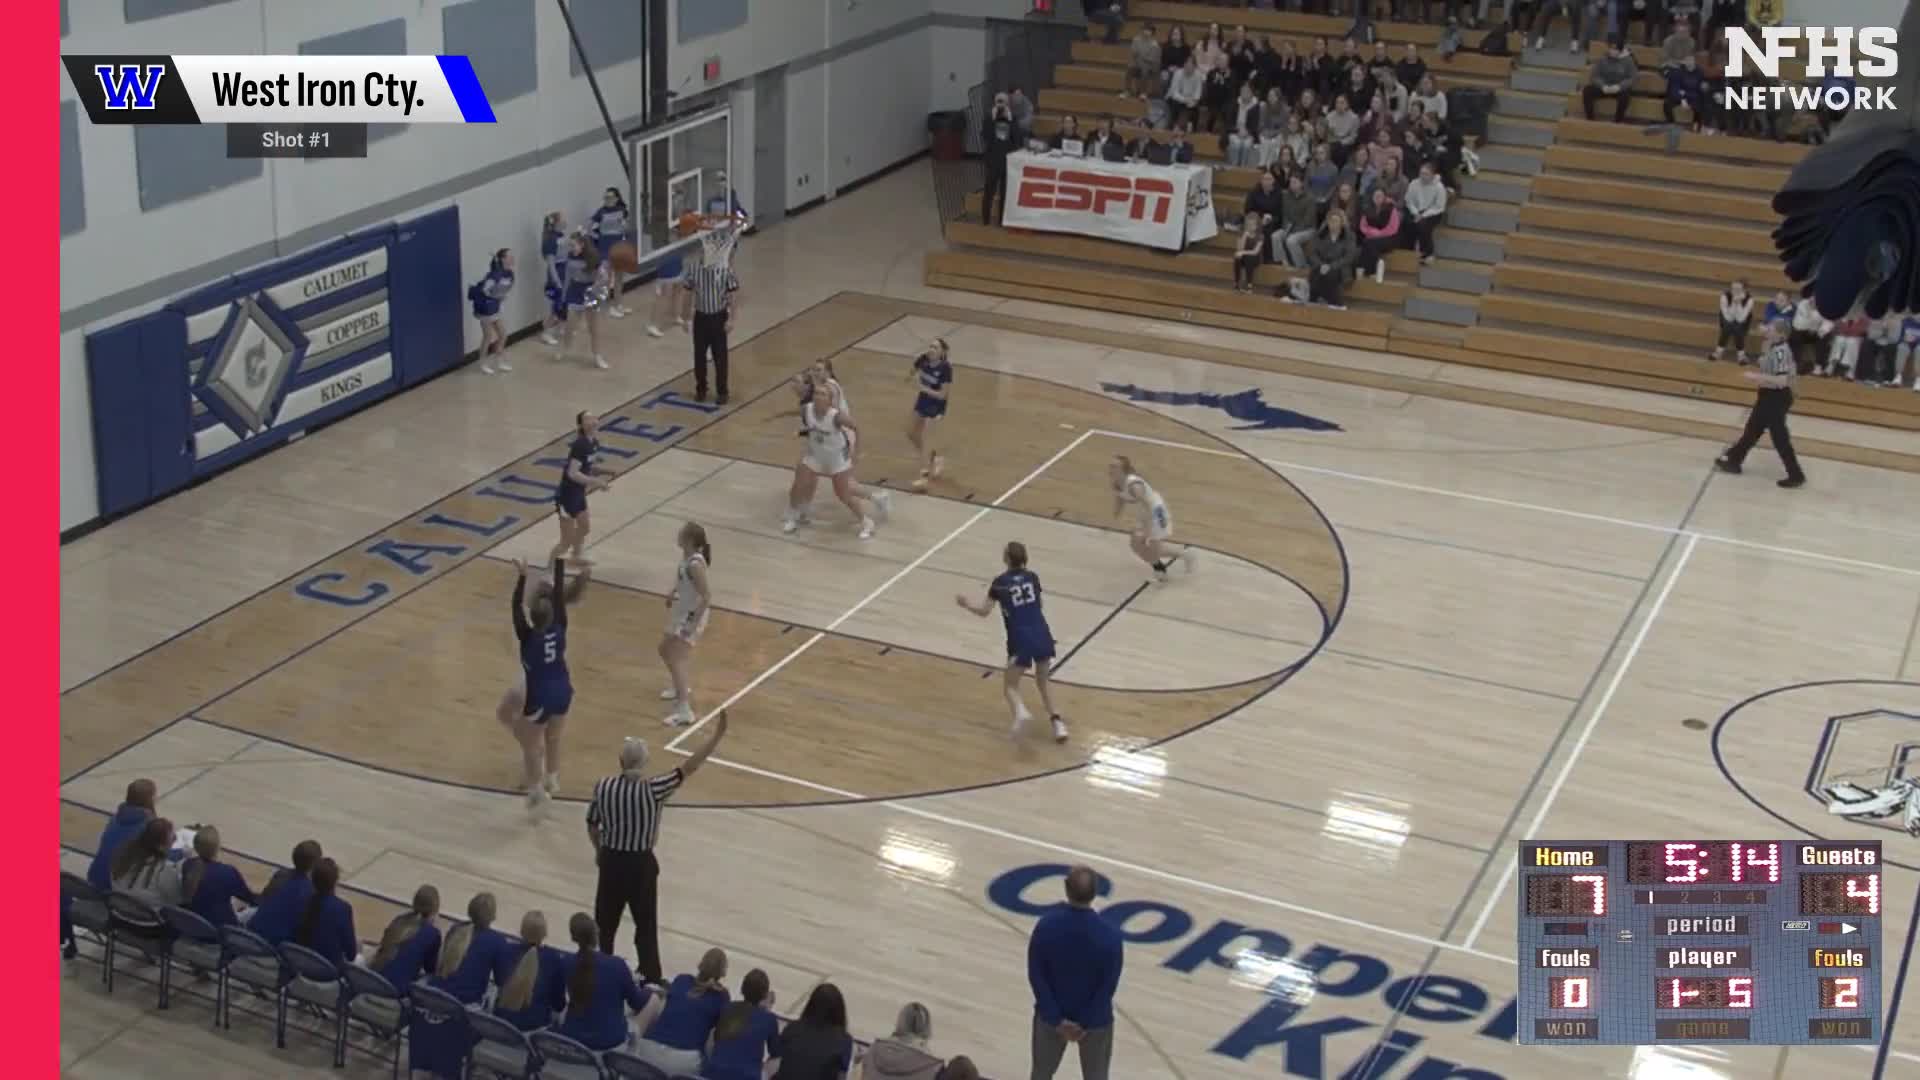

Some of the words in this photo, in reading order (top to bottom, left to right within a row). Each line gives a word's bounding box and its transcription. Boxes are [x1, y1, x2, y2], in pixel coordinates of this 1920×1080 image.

[1018, 166, 1174, 224] ESPN
[303, 261, 369, 298] CALUMET
[326, 311, 380, 345] COPPER
[320, 372, 364, 403] KINGS
[1009, 582, 1036, 607] 23
[544, 641, 557, 664] 5
